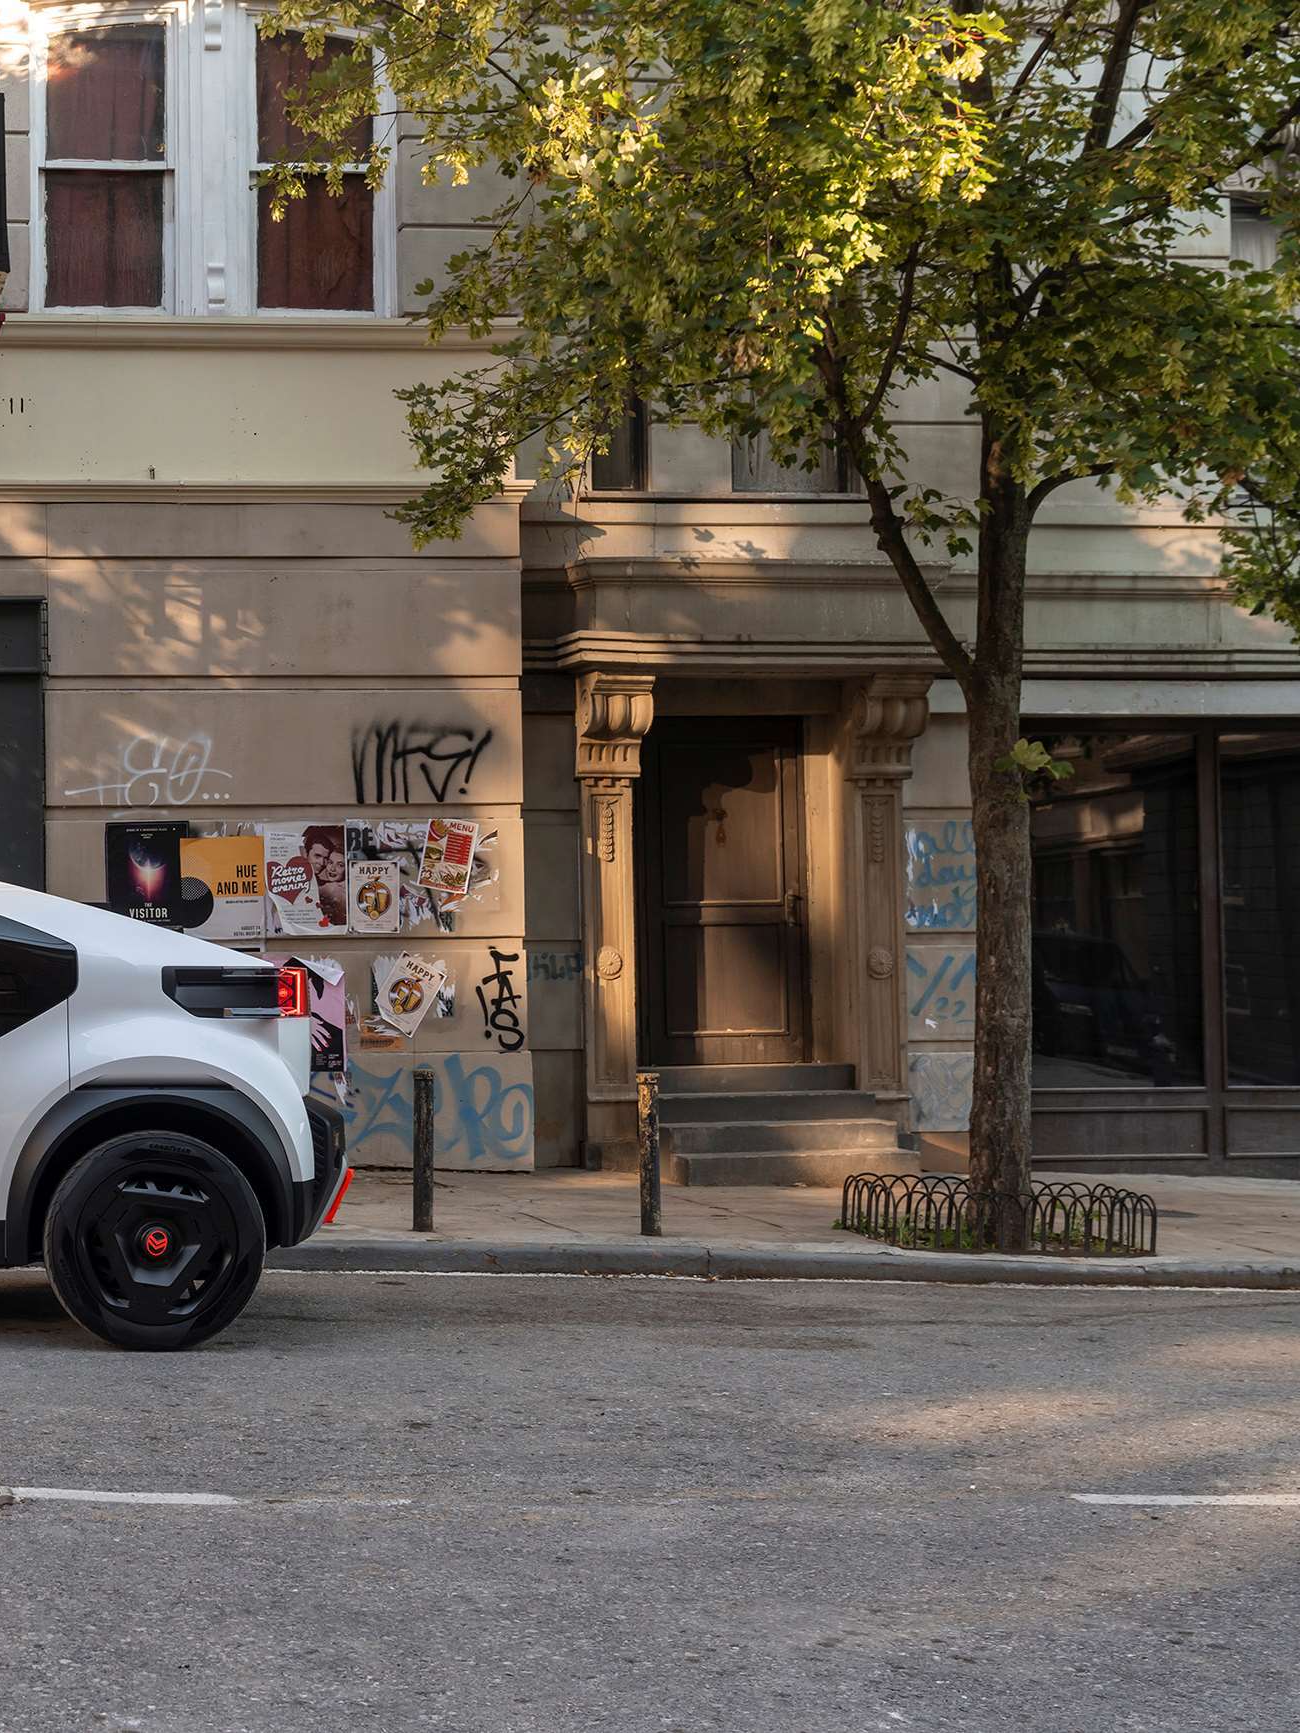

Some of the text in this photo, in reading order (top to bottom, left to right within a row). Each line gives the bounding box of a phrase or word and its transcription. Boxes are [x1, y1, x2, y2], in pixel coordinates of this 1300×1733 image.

[448, 821, 475, 834] MENU
[236, 864, 258, 878] HUE
[271, 864, 305, 878] Retro
[359, 866, 390, 876] HAPPY
[271, 874, 308, 886] movies
[216, 880, 259, 895] AND ME
[271, 881, 311, 894] evening
[129, 907, 169, 919] VISITOR
[406, 960, 436, 982] HAPPY
